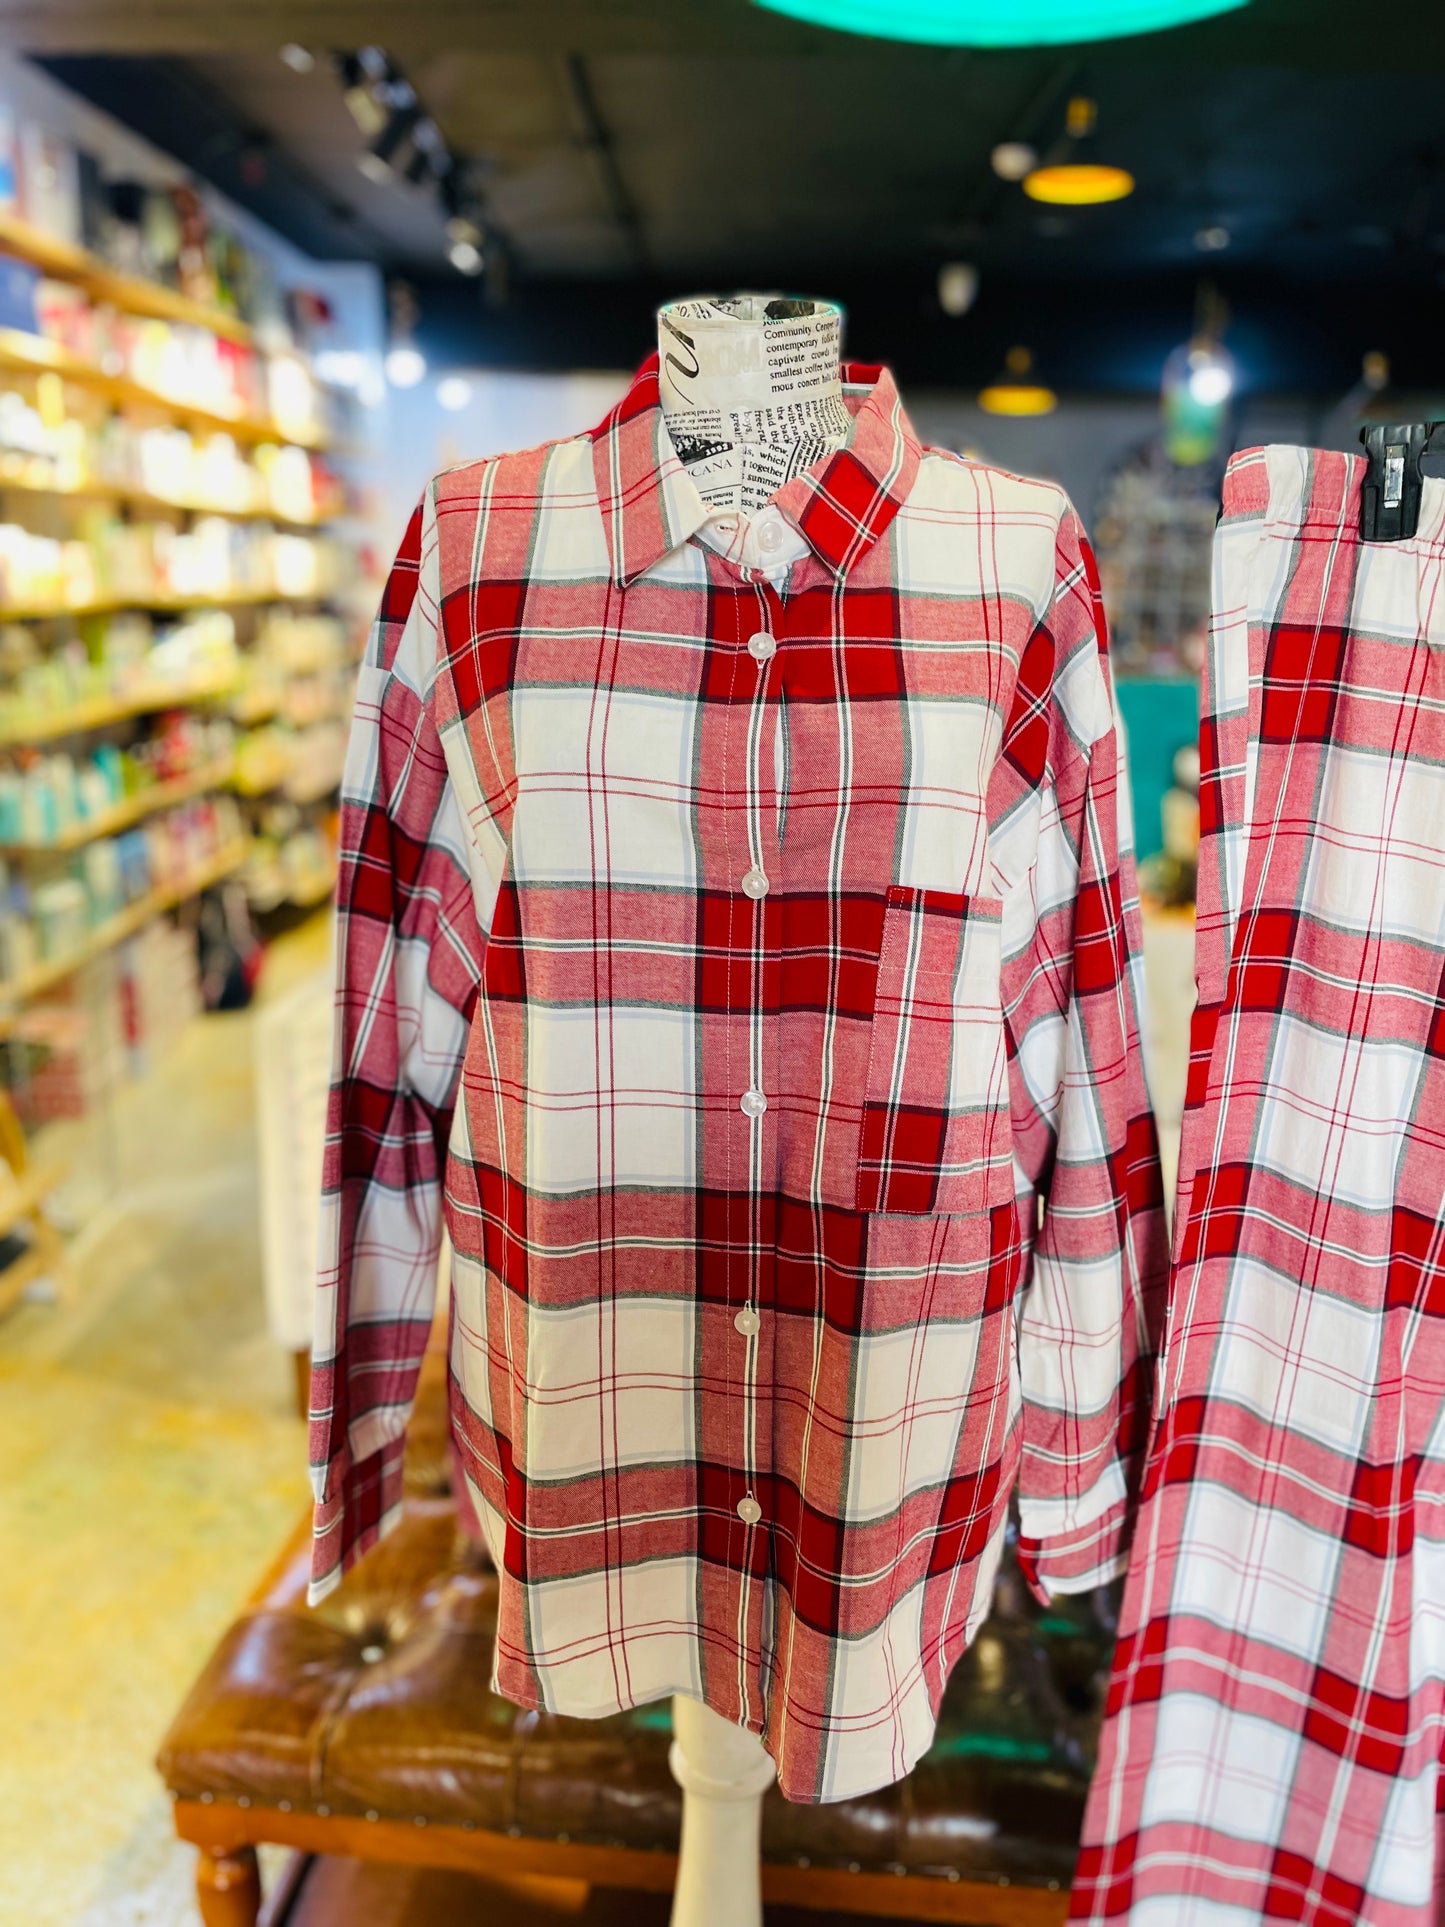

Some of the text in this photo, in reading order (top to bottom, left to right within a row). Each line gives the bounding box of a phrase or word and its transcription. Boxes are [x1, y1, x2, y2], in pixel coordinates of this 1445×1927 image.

[764, 324, 811, 340] Community
[766, 338, 818, 353] contemporary
[768, 354, 805, 367] captivate
[770, 368, 802, 380] smallest
[772, 382, 794, 392] mous
[798, 378, 820, 388] concert
[766, 408, 776, 427] said
[776, 406, 785, 420] the
[787, 404, 796, 424] with
[810, 422, 818, 438] day
[760, 452, 787, 467] which
[750, 461, 784, 478] together
[747, 474, 782, 489] summer
